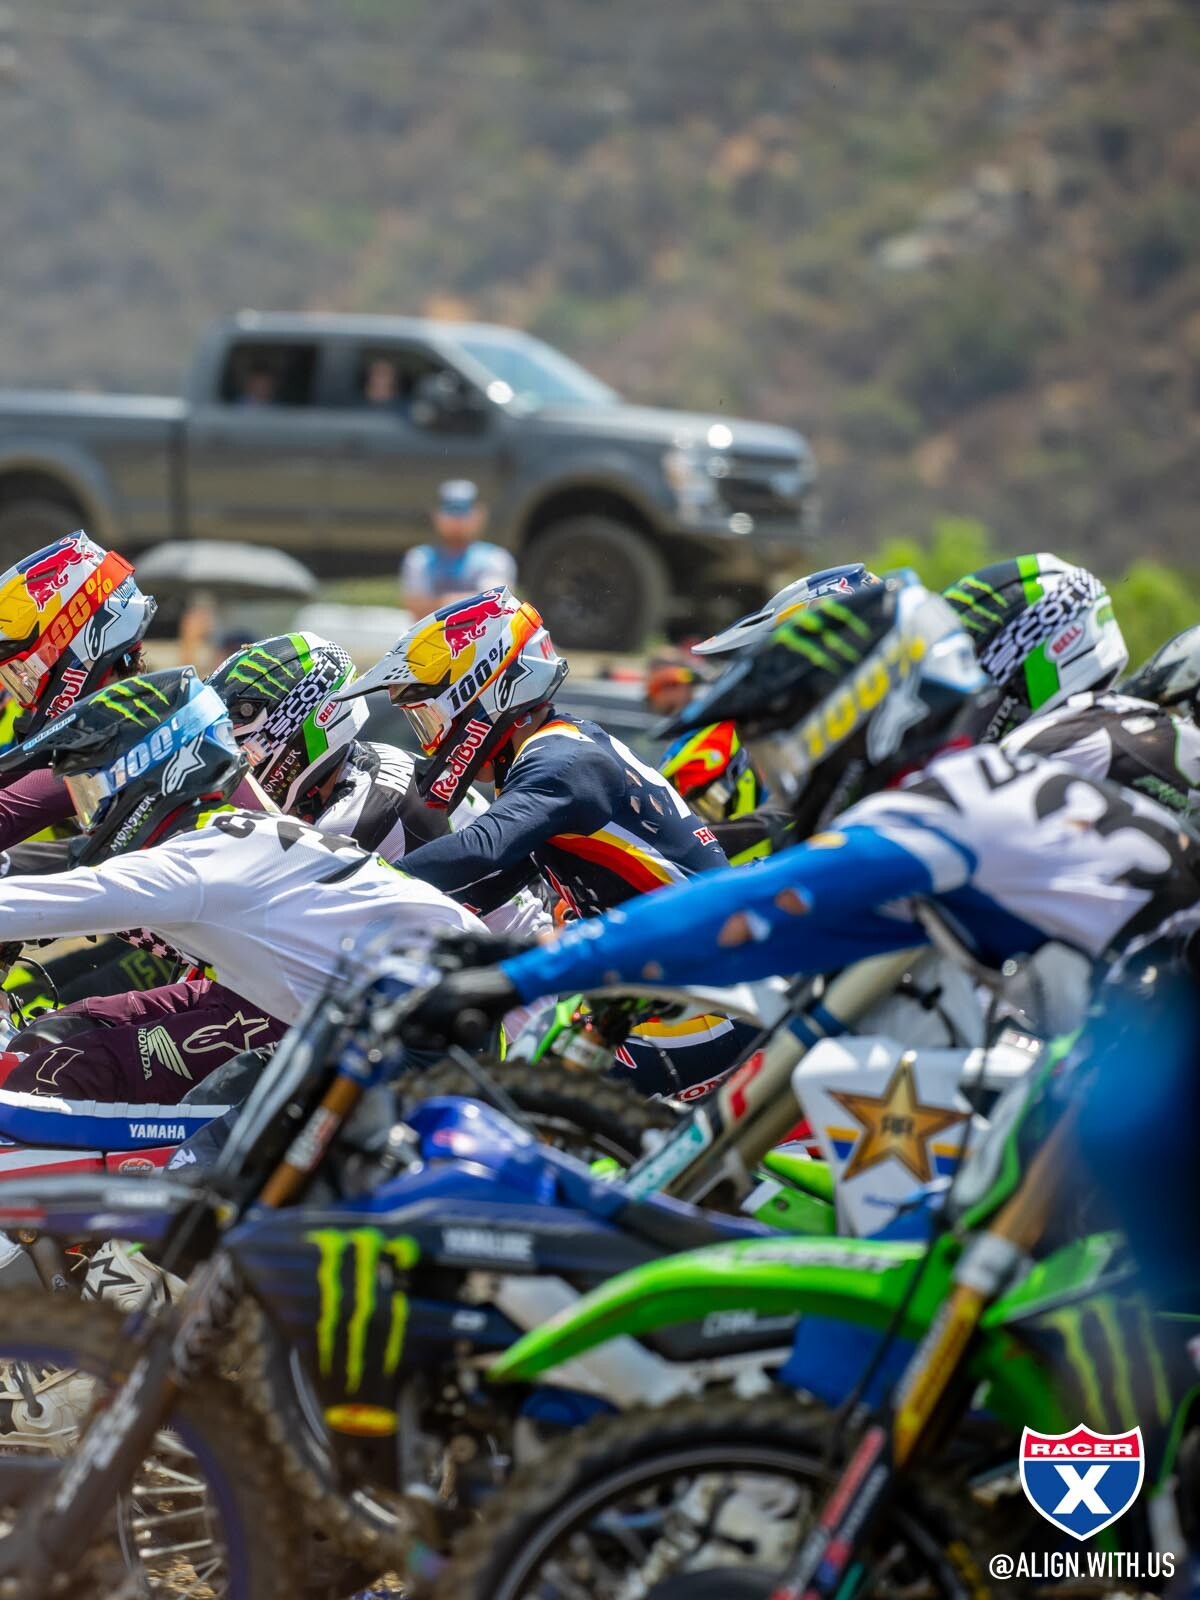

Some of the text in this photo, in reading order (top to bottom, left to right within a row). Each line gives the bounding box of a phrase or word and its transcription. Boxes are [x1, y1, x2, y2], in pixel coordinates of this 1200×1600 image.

[988, 580, 1093, 678] SCOTT
[1052, 626, 1081, 655] BELL
[270, 658, 338, 737] SCOTT
[263, 748, 302, 794] ONSTER
[110, 795, 156, 852] MONSTER
[137, 1027, 153, 1081] HONDA
[129, 1124, 186, 1140] YAMAHA
